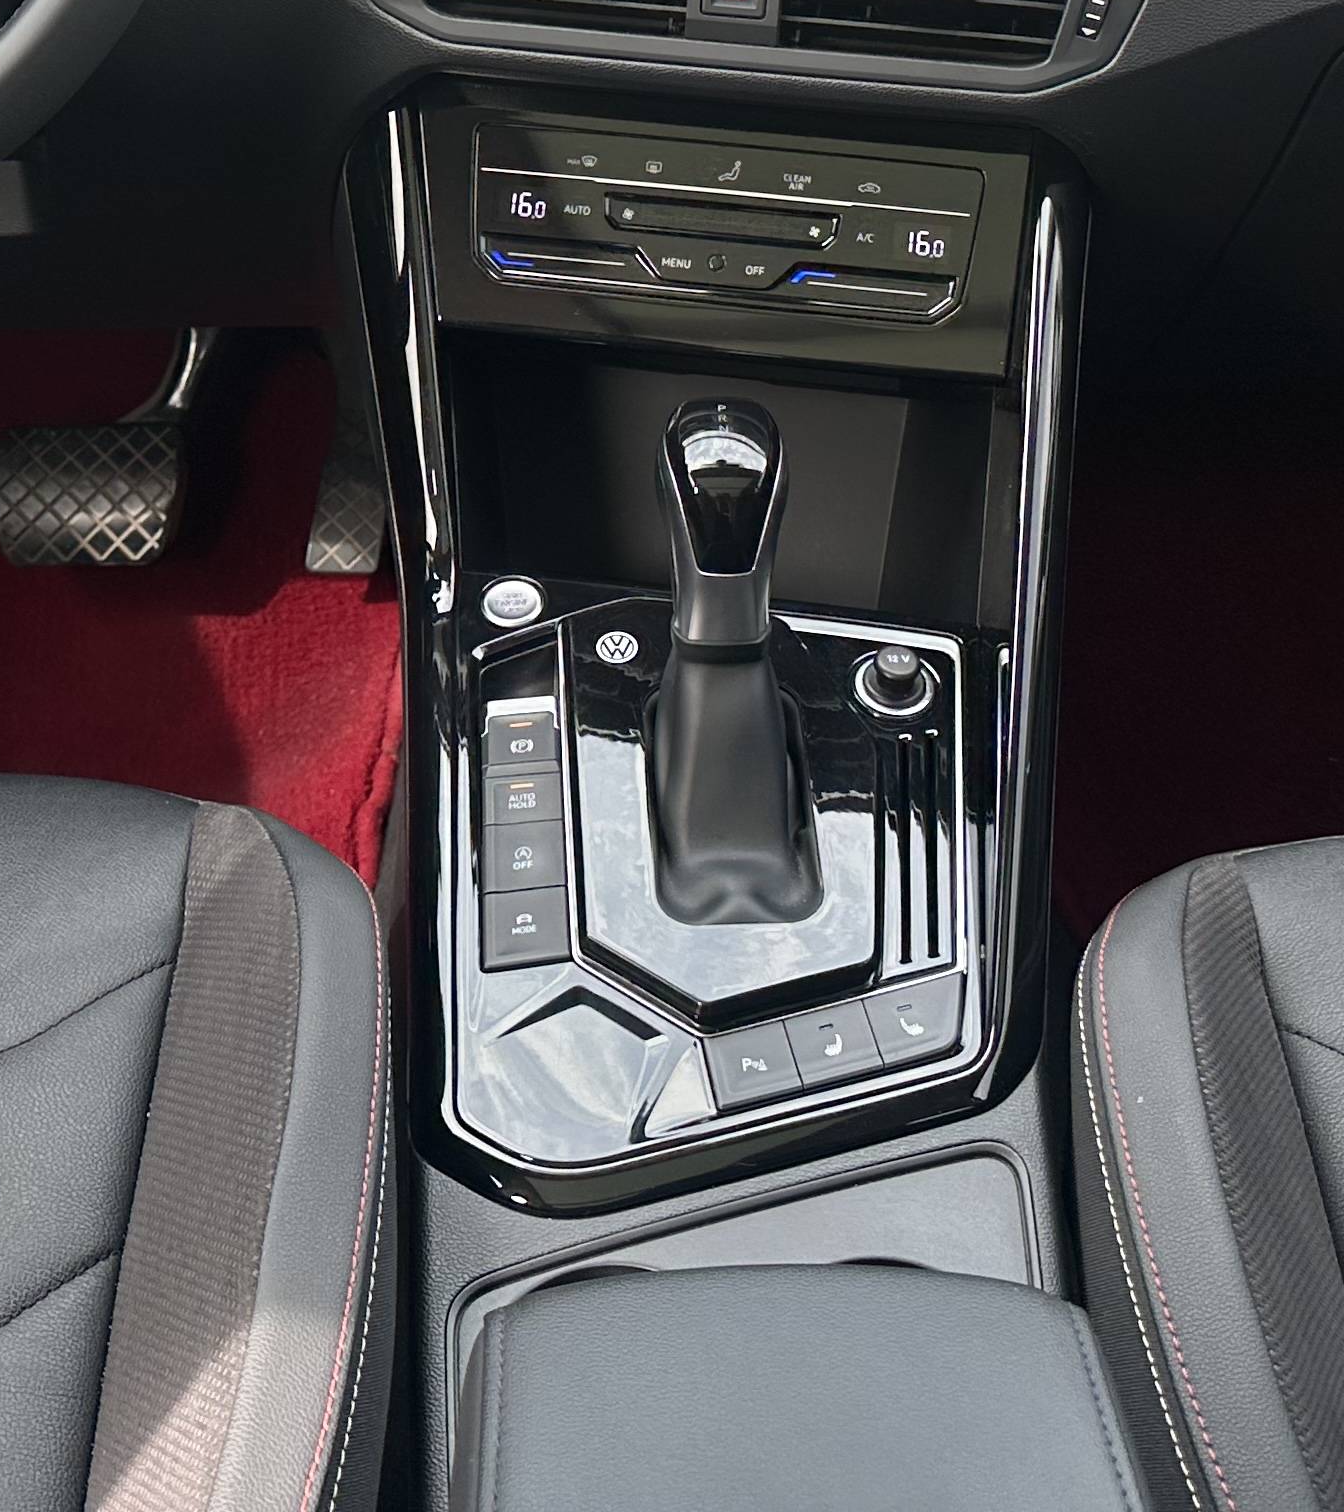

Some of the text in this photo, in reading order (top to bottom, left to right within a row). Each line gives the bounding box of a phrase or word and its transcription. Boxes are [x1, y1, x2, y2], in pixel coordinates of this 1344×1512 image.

[783, 173, 812, 184] CLEAN
[788, 183, 804, 191] AIR
[510, 191, 547, 220] 16.0
[563, 204, 591, 216] AUTO
[856, 232, 875, 243] A/C
[907, 230, 945, 258] 16.0
[661, 257, 692, 269] MENU
[745, 265, 765, 276] OFF
[886, 654, 911, 663] 12 V
[508, 792, 536, 802] AUTO
[508, 800, 536, 810] HOLD
[512, 860, 534, 870] OFF
[511, 924, 536, 935] MODE
